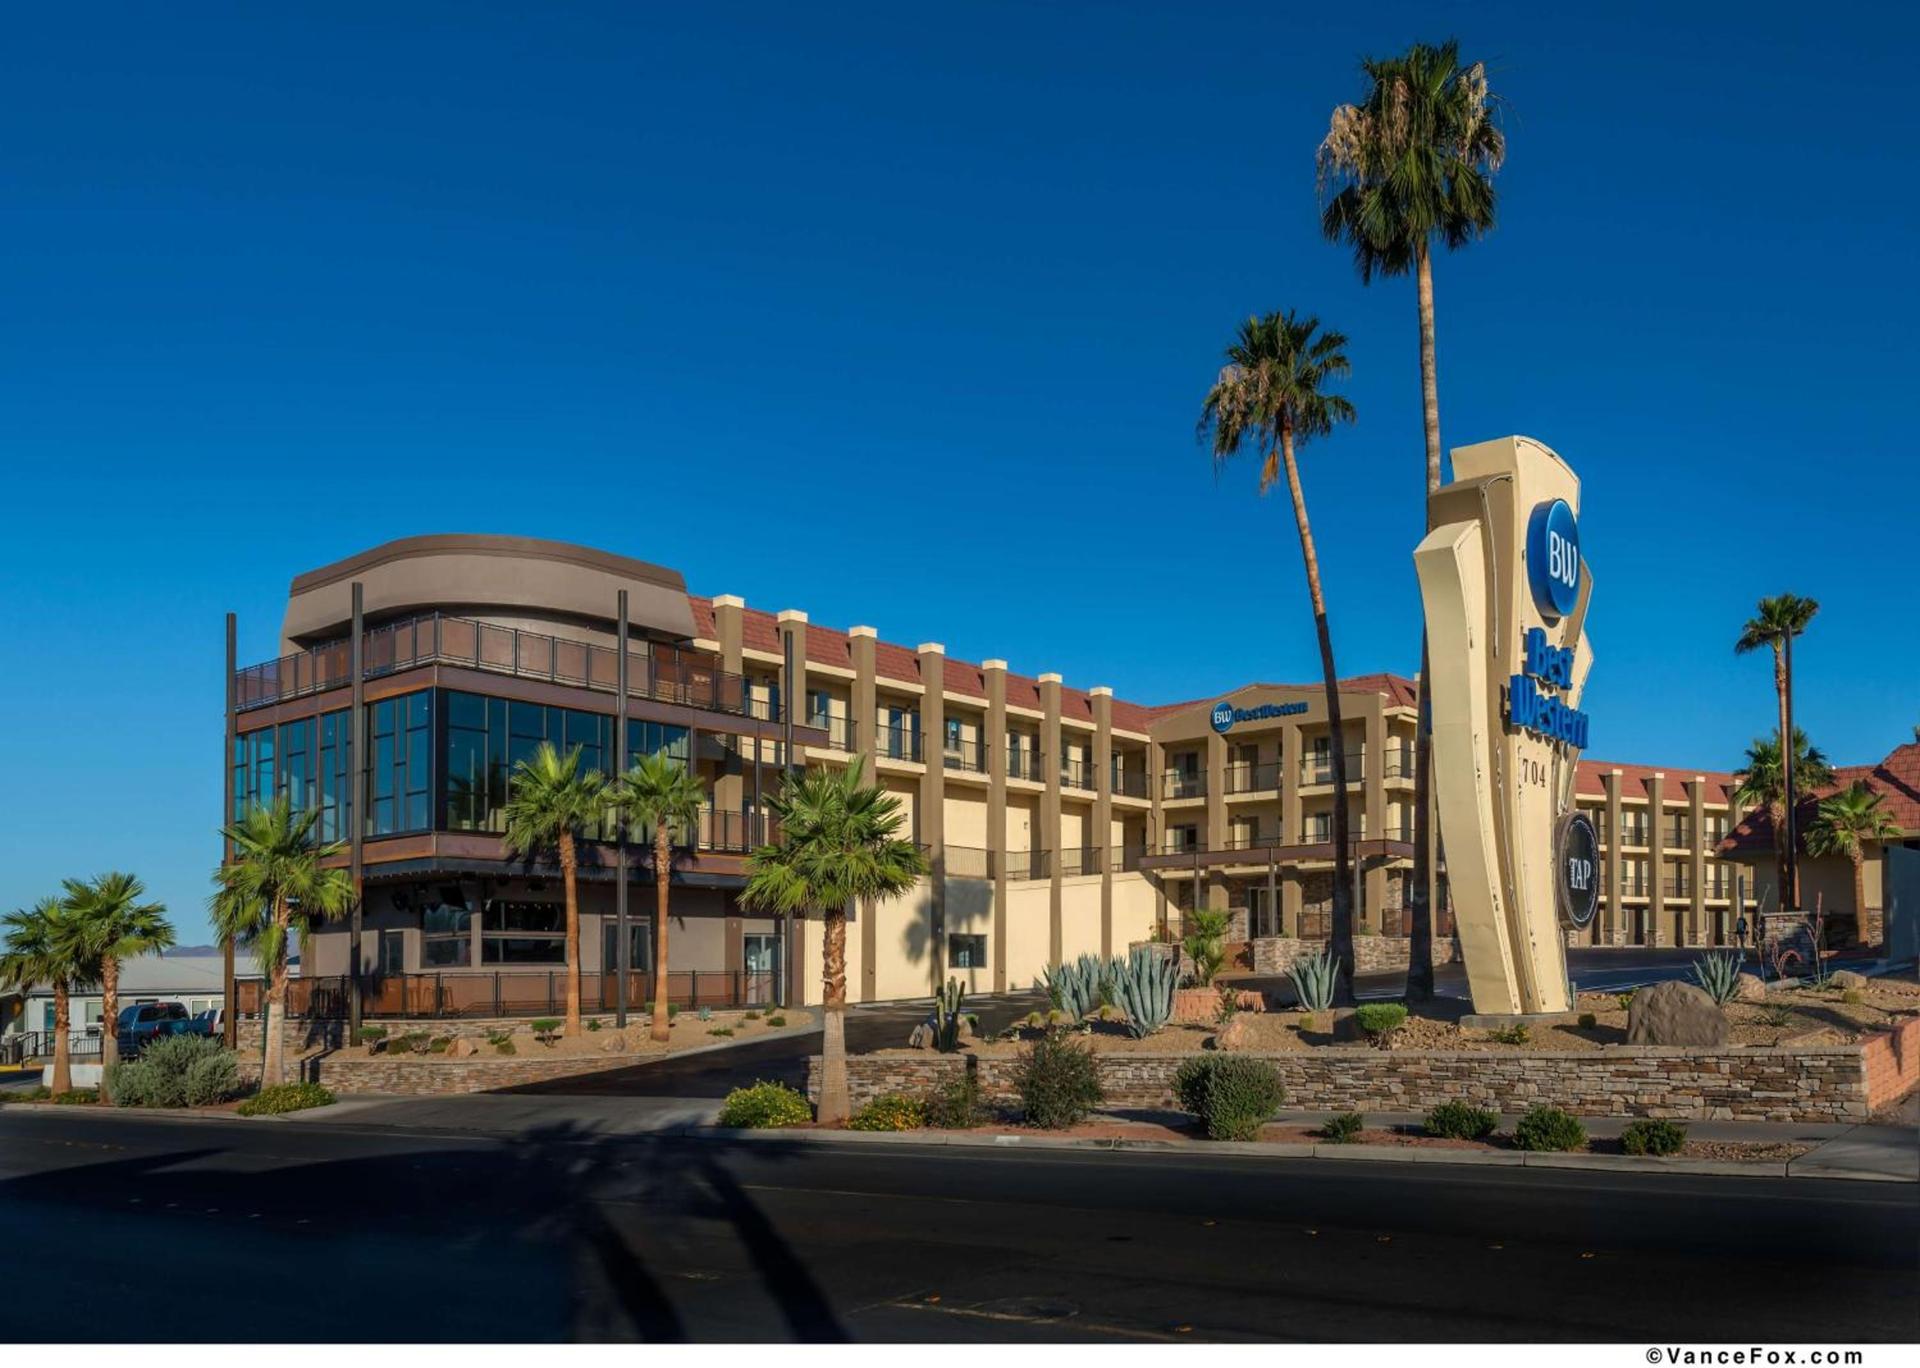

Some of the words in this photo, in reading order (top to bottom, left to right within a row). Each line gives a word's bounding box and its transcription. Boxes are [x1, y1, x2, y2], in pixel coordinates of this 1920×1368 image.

[1549, 530, 1577, 588] BW
[1527, 627, 1574, 690] Best
[1214, 710, 1232, 724] BW
[1510, 674, 1589, 750] Western
[1523, 758, 1546, 788] 704
[1569, 858, 1591, 890] TAP
